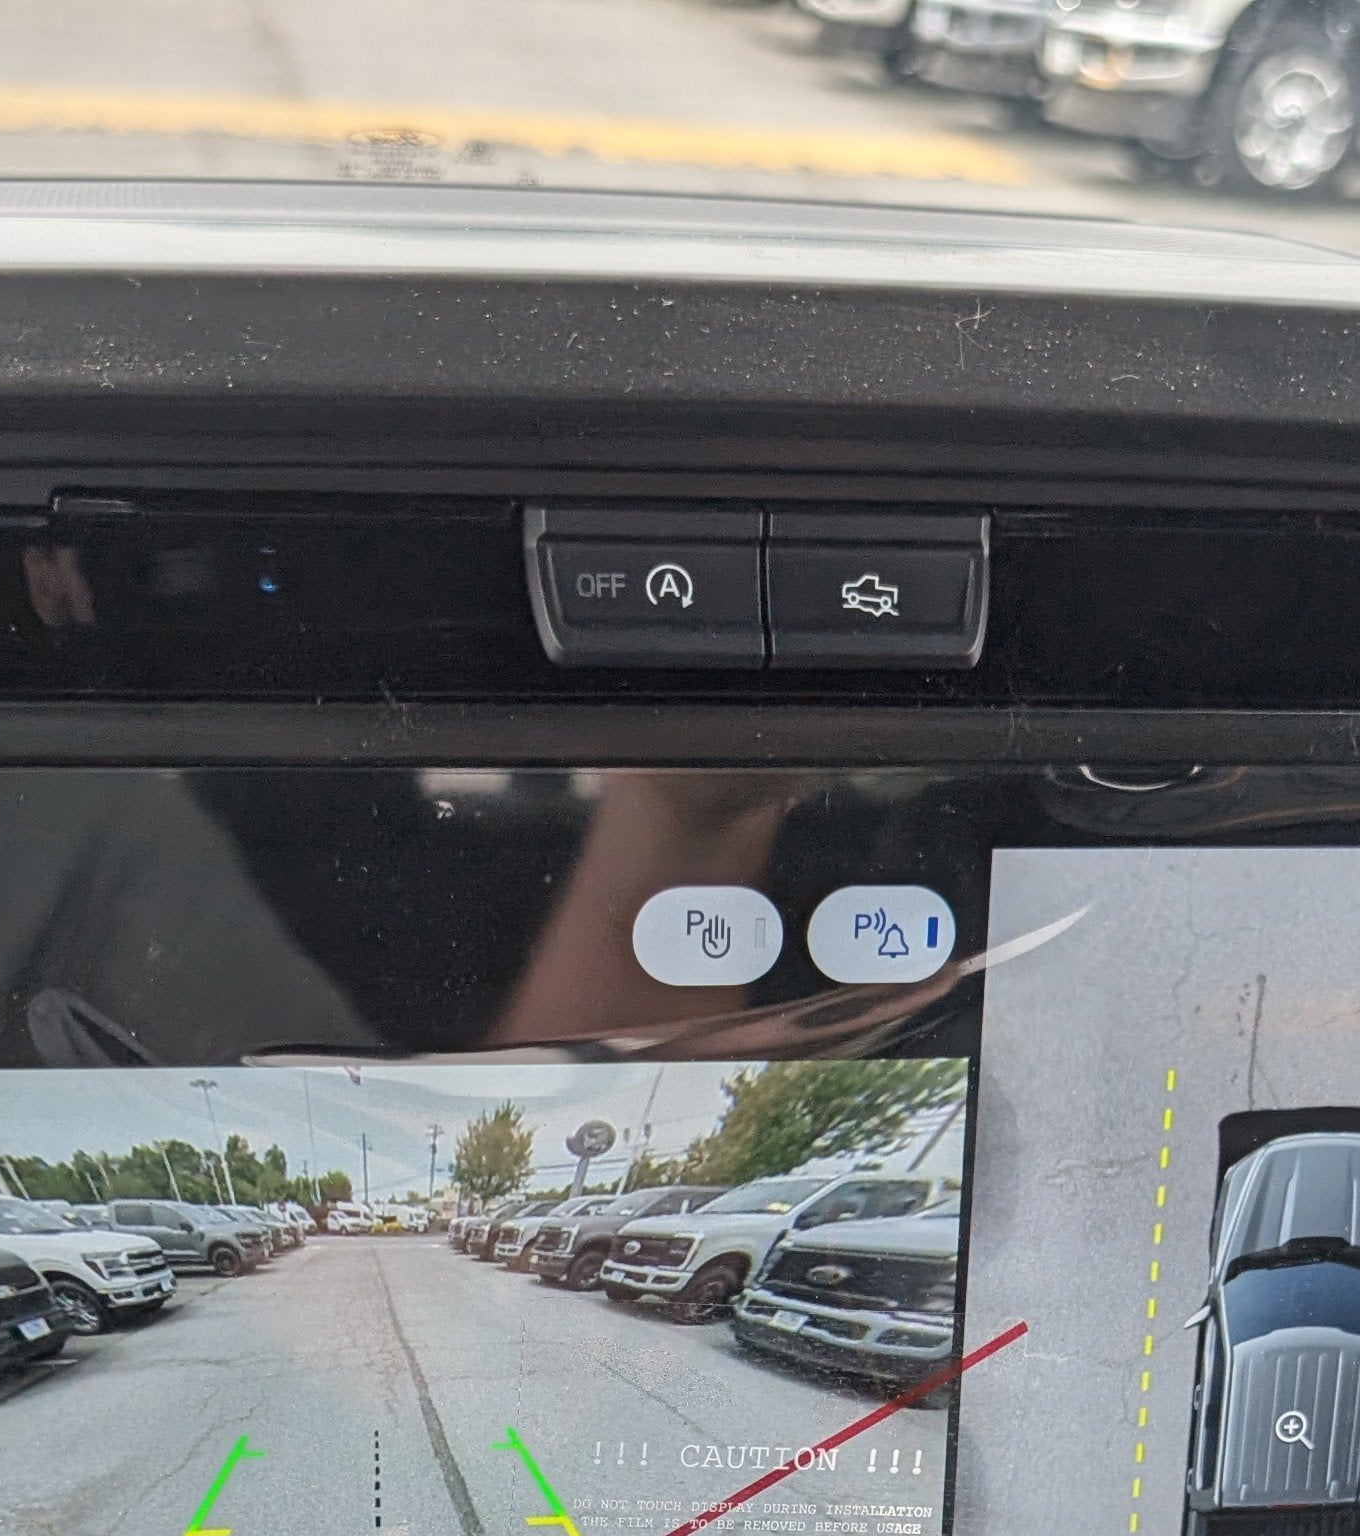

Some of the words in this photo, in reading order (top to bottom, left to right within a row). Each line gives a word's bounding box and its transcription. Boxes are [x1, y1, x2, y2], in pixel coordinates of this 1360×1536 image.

[576, 573, 626, 598] OFF
[680, 1444, 840, 1472] CAUTION
[573, 1498, 591, 1510] DO
[601, 1499, 629, 1511] NOT
[637, 1500, 682, 1511] TOUCH
[691, 1501, 755, 1513] DISPLAY
[763, 1503, 817, 1516] DURING
[826, 1504, 933, 1518] INSTALLATION
[581, 1516, 608, 1527] THE
[618, 1517, 653, 1528] FILM
[664, 1518, 680, 1529] IS
[690, 1518, 708, 1530] TO
[717, 1519, 735, 1530] BE
[743, 1520, 806, 1532] REMOVED
[815, 1522, 868, 1533] BEFORE
[876, 1523, 923, 1535] USAGE
